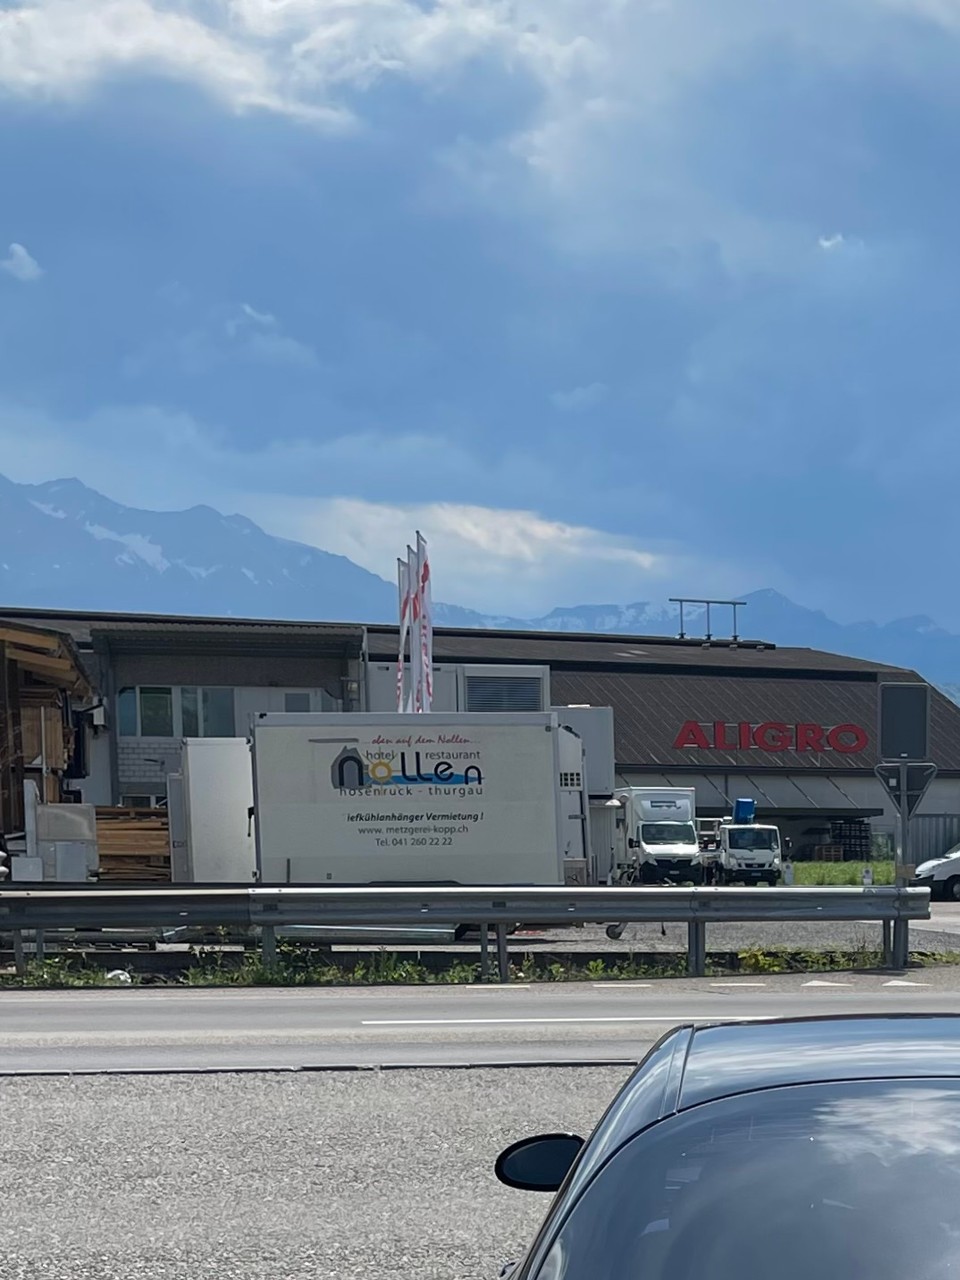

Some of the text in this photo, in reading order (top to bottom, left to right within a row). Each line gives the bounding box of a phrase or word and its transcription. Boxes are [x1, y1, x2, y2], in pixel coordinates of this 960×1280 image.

[672, 719, 870, 754] ALIGRO
[365, 750, 481, 760] hotel restaurant
[428, 785, 483, 798] thurgau
[347, 812, 424, 823] iefkühlanhänger
[426, 812, 479, 823] Vermietung
[392, 838, 407, 846] 041
[411, 838, 427, 846] 260
[429, 838, 440, 846] 22
[442, 838, 453, 846] 22
